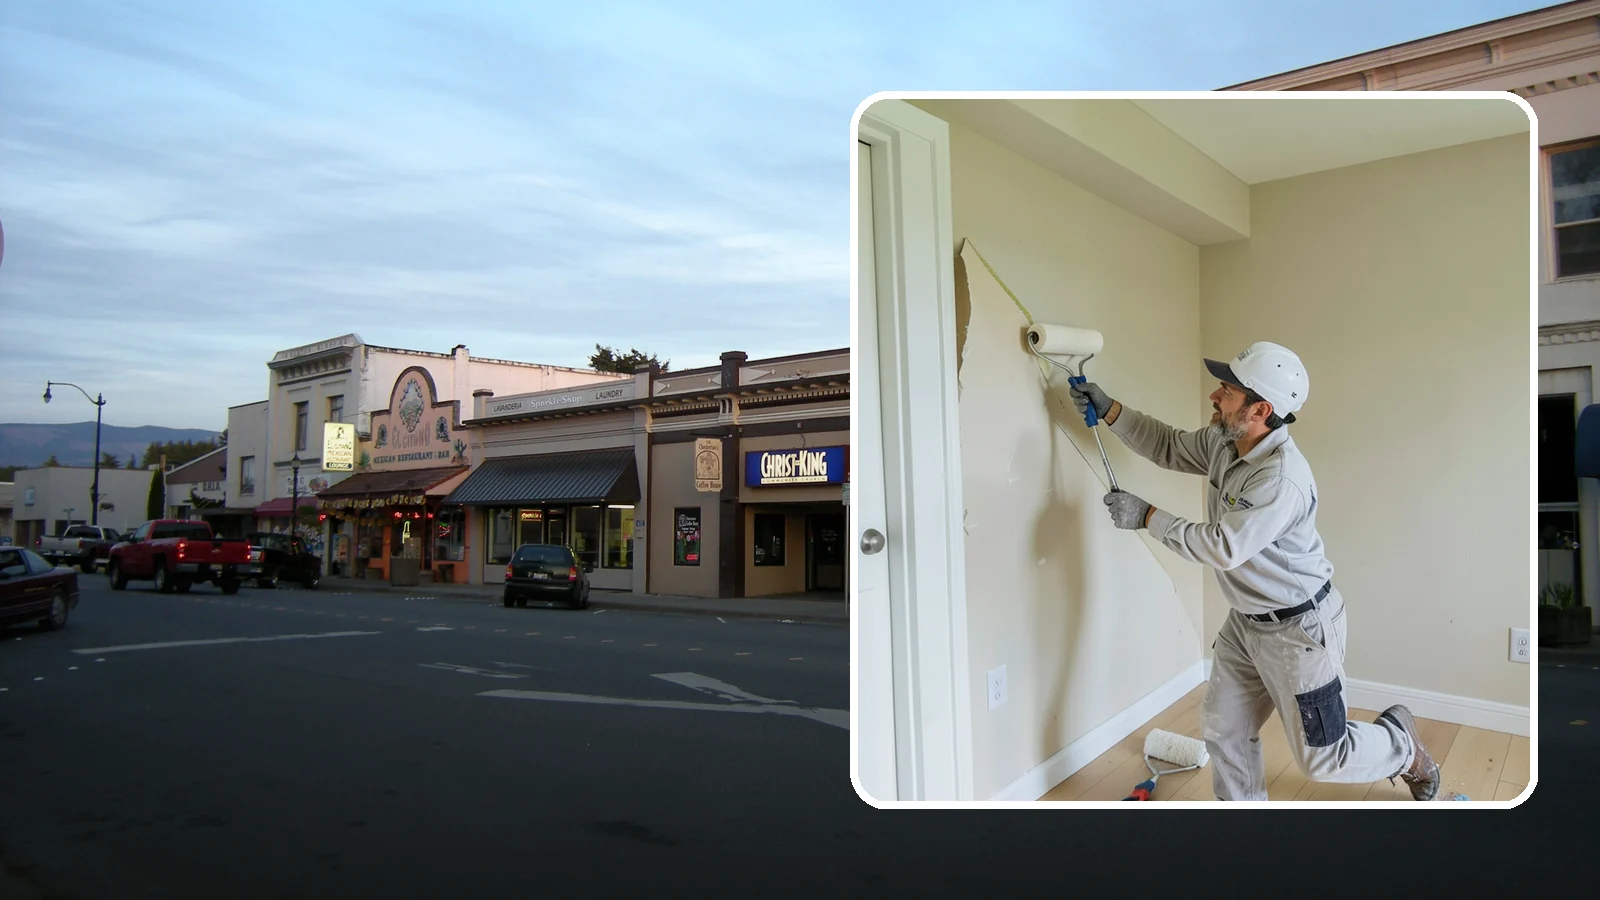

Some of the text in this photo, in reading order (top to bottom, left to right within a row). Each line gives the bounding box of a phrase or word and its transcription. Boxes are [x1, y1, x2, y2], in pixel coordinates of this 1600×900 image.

[493, 389, 623, 412] LAVANDERIA Sparkle Shop LAUNDRY
[373, 450, 450, 464] MEXICAN RESTAURANT BAR
[760, 450, 827, 478] CHRIST KING
